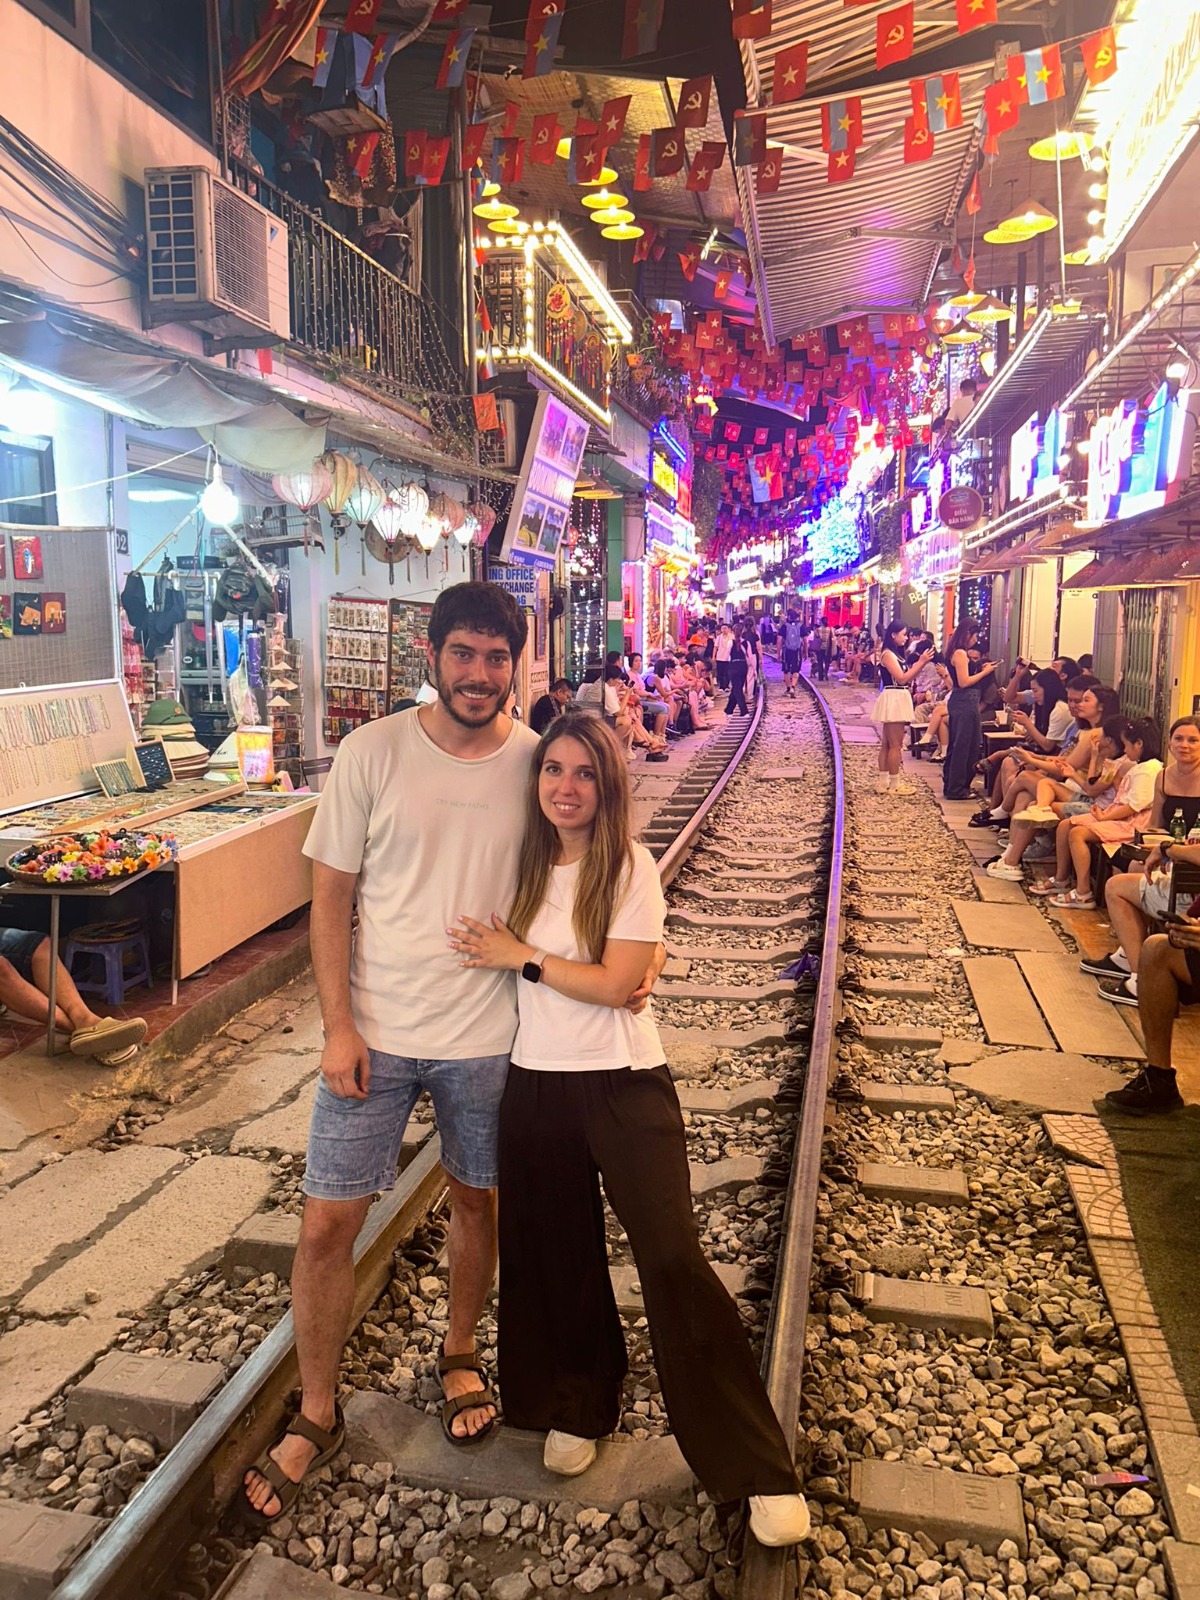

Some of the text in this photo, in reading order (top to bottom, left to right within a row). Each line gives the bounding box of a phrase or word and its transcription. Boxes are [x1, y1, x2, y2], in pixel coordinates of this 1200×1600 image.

[506, 569, 534, 580] OFFICE
[449, 800, 467, 808] NEW
[467, 802, 489, 811] PATHS
